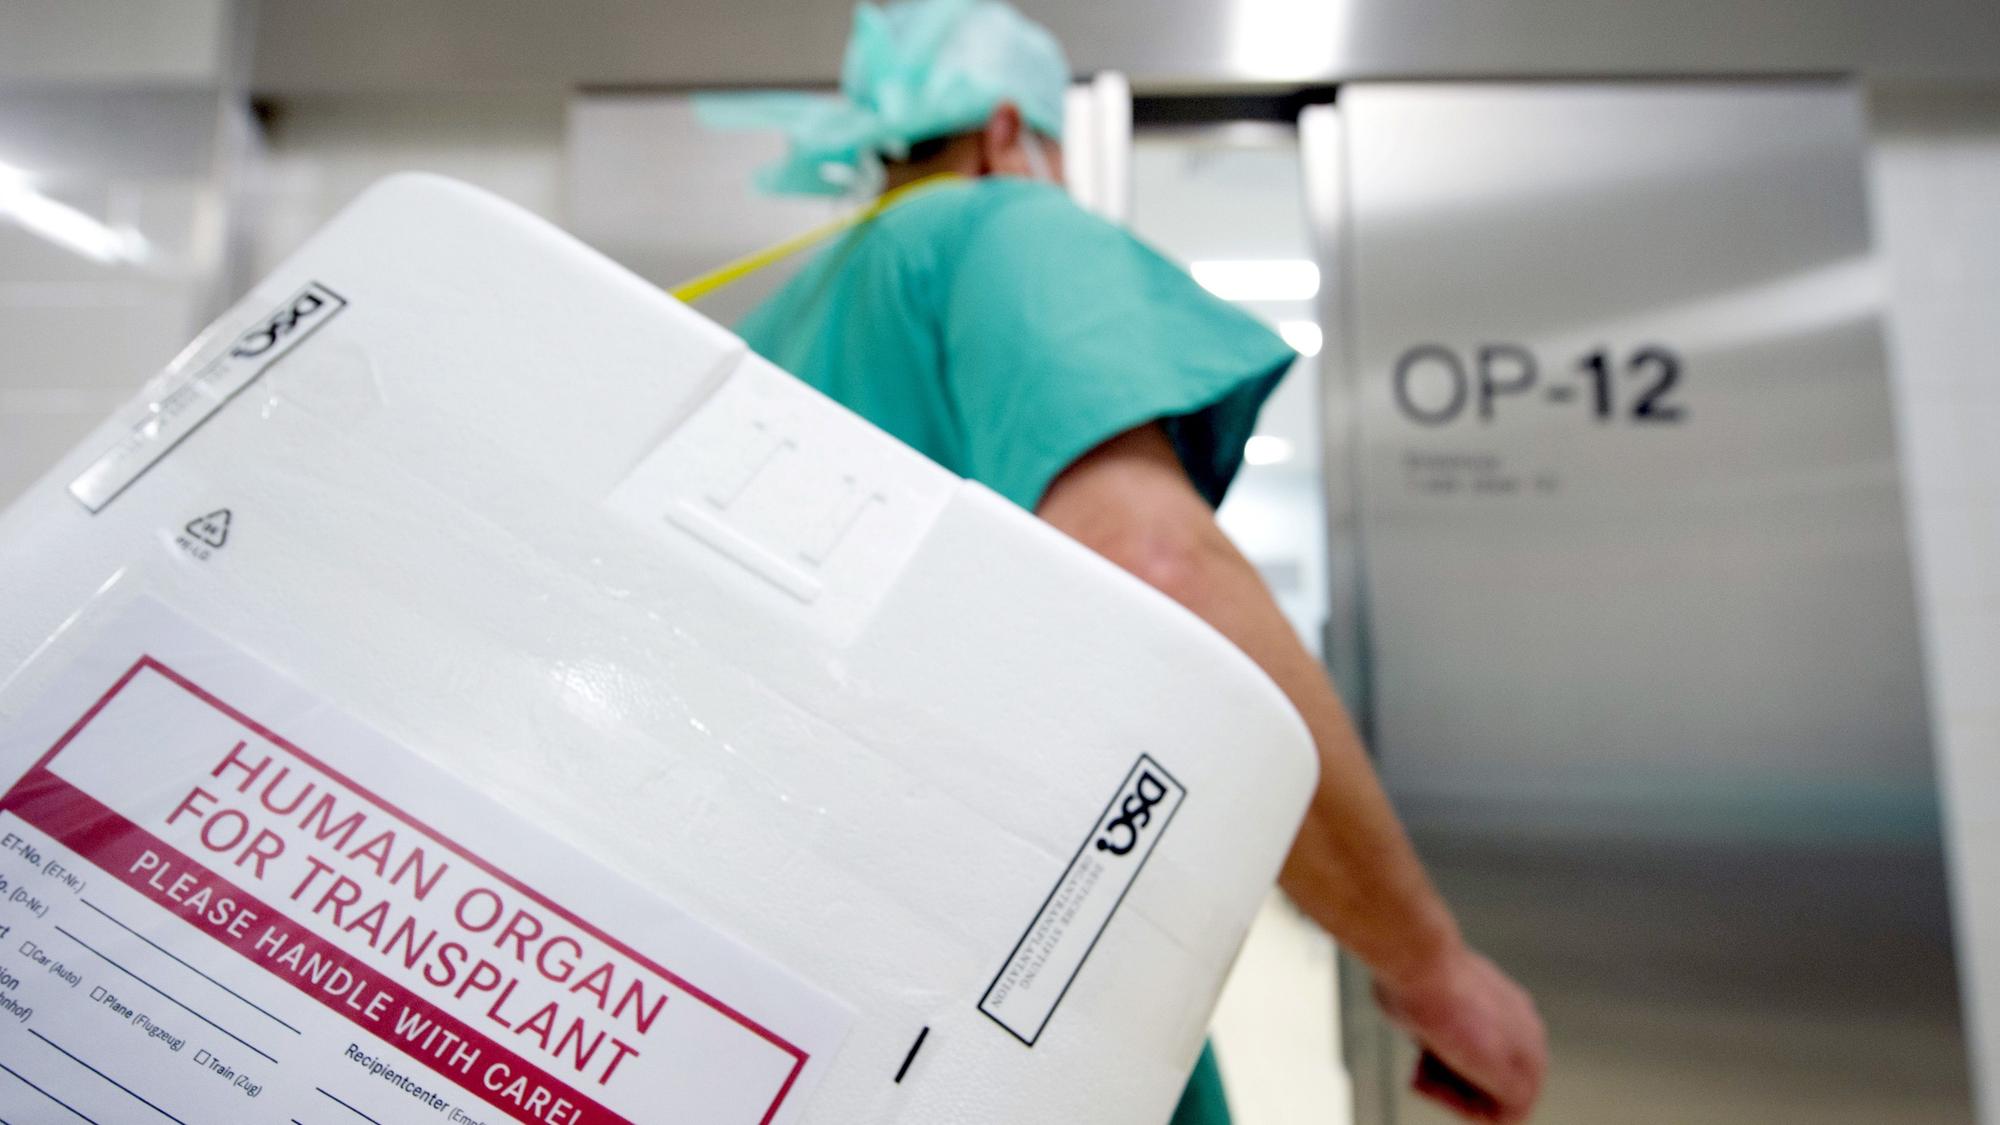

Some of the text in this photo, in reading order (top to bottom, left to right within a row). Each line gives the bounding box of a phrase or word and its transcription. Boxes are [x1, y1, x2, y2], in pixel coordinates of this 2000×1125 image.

[1393, 343, 1690, 427] OP-12
[1, 833, 86, 894] ET-No. (ET-Nr.)
[9, 886, 49, 918] (D-Nr.)
[210, 740, 669, 1036] HUMAN ORGAN
[129, 850, 257, 939] PLEASE
[254, 921, 395, 1023] HANDLE
[394, 1006, 482, 1074] WITH
[165, 786, 640, 1086] FOR TRANSPLANT
[1018, 927, 1063, 990] STIFTUNG
[32, 949, 263, 1098] Car (Auto) Plane (Flugzeug) Train (Zug)
[344, 1043, 451, 1112] Recipientcenter
